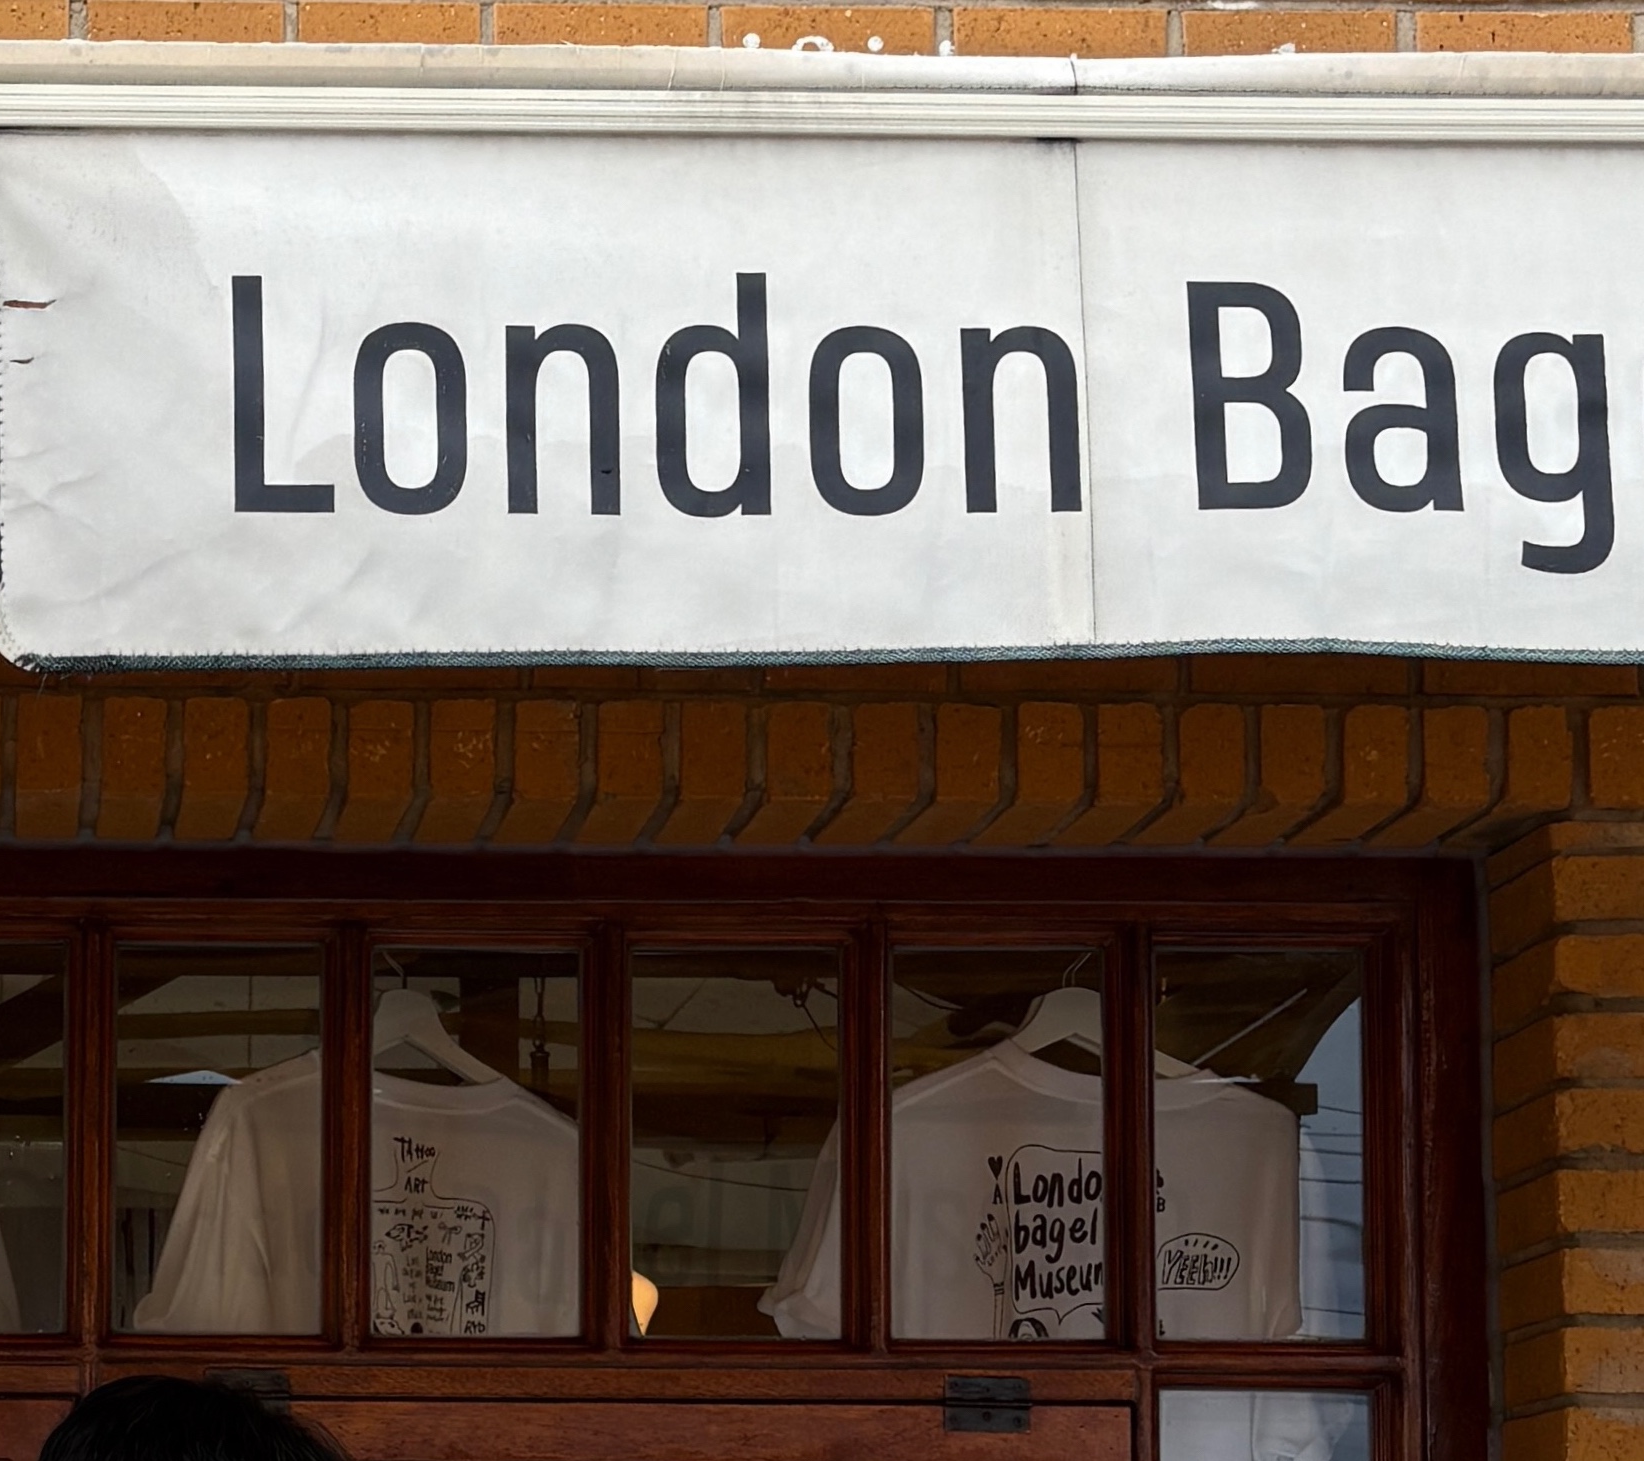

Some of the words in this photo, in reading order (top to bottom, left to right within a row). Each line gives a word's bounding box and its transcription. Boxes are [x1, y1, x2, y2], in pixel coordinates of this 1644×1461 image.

[231, 272, 1085, 519] London
[1185, 280, 1616, 575] Bag
[1013, 1158, 1103, 1208] Londo
[1014, 1208, 1099, 1263] bagel
